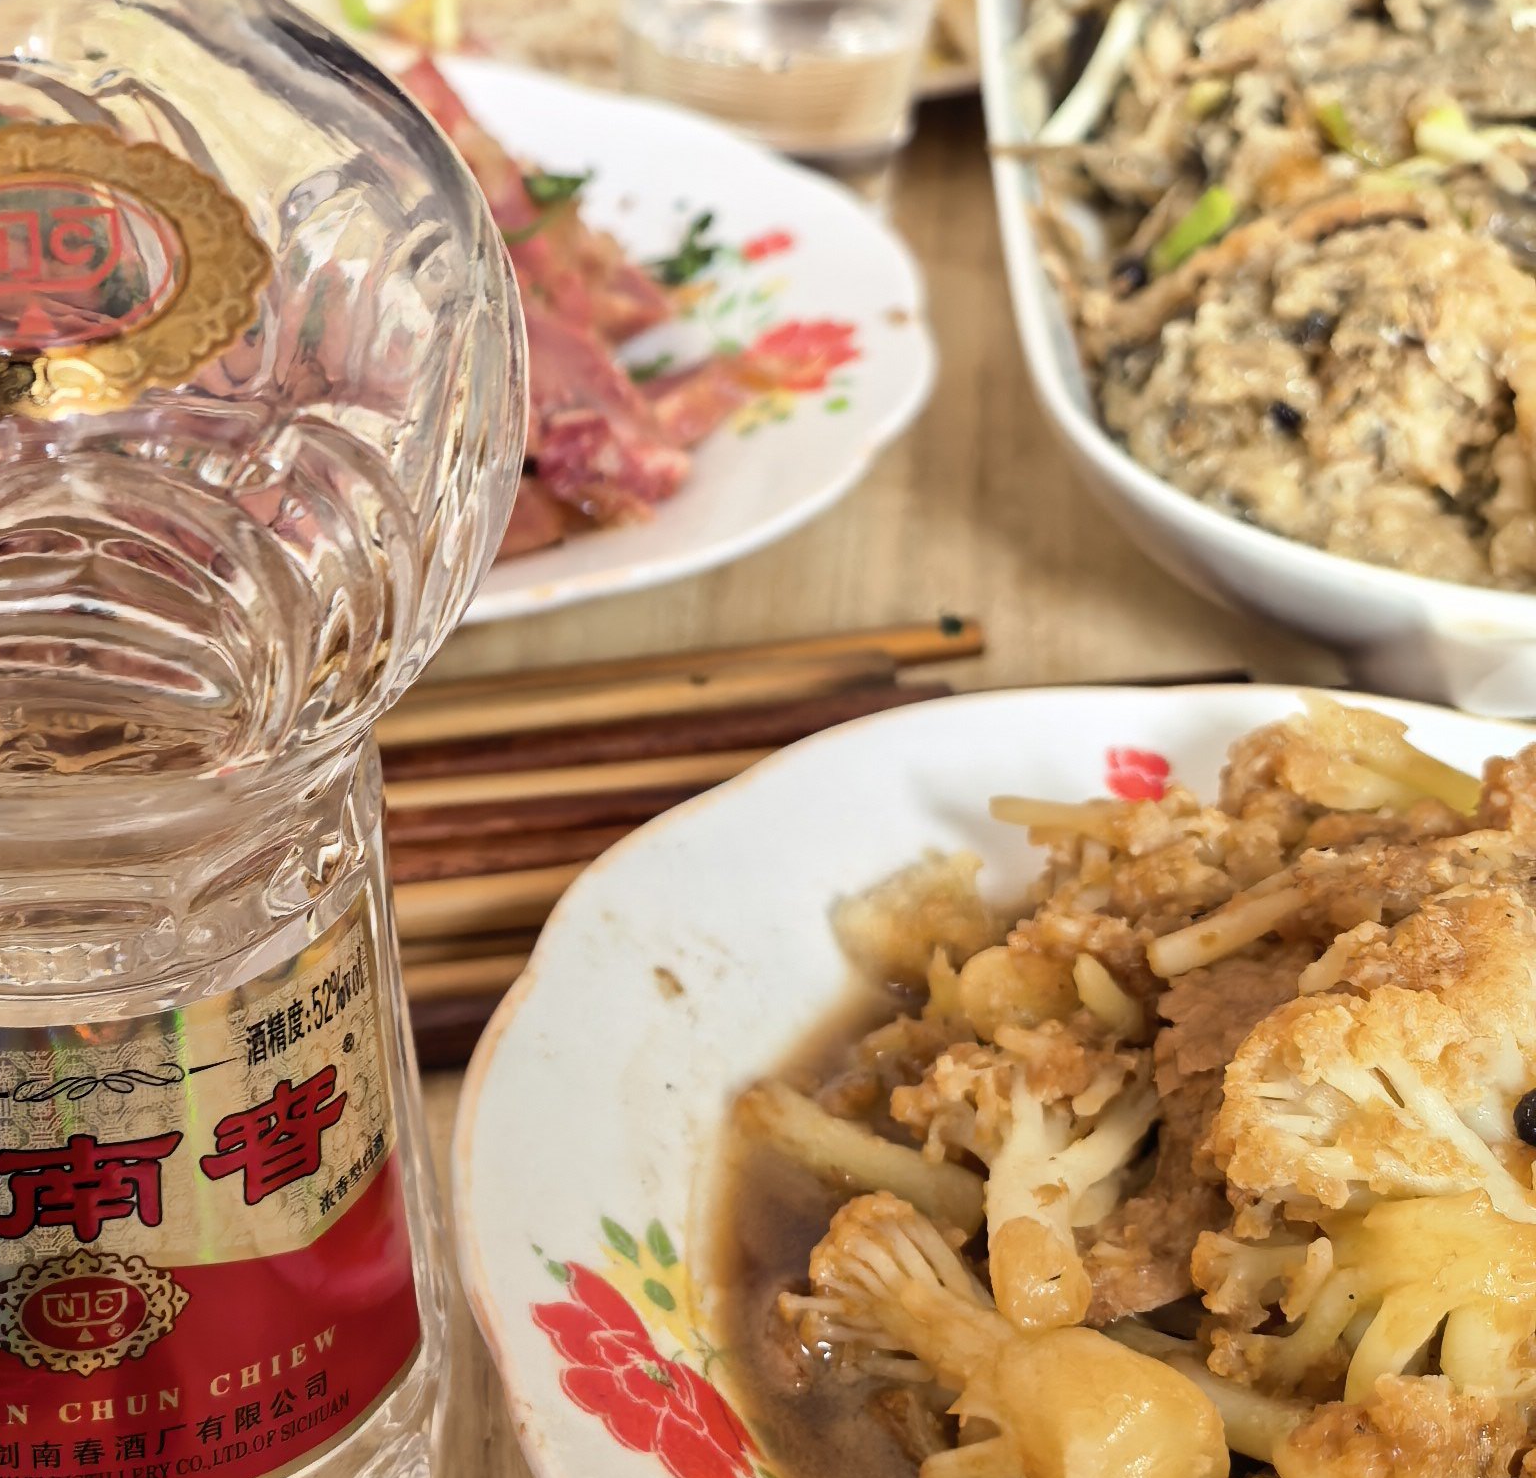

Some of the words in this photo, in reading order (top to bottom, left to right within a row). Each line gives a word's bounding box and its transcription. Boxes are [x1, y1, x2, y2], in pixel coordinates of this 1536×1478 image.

[58, 1387, 180, 1424] CHUN
[209, 1324, 337, 1397] CHIEW
[279, 1390, 351, 1443] SICHUAN
